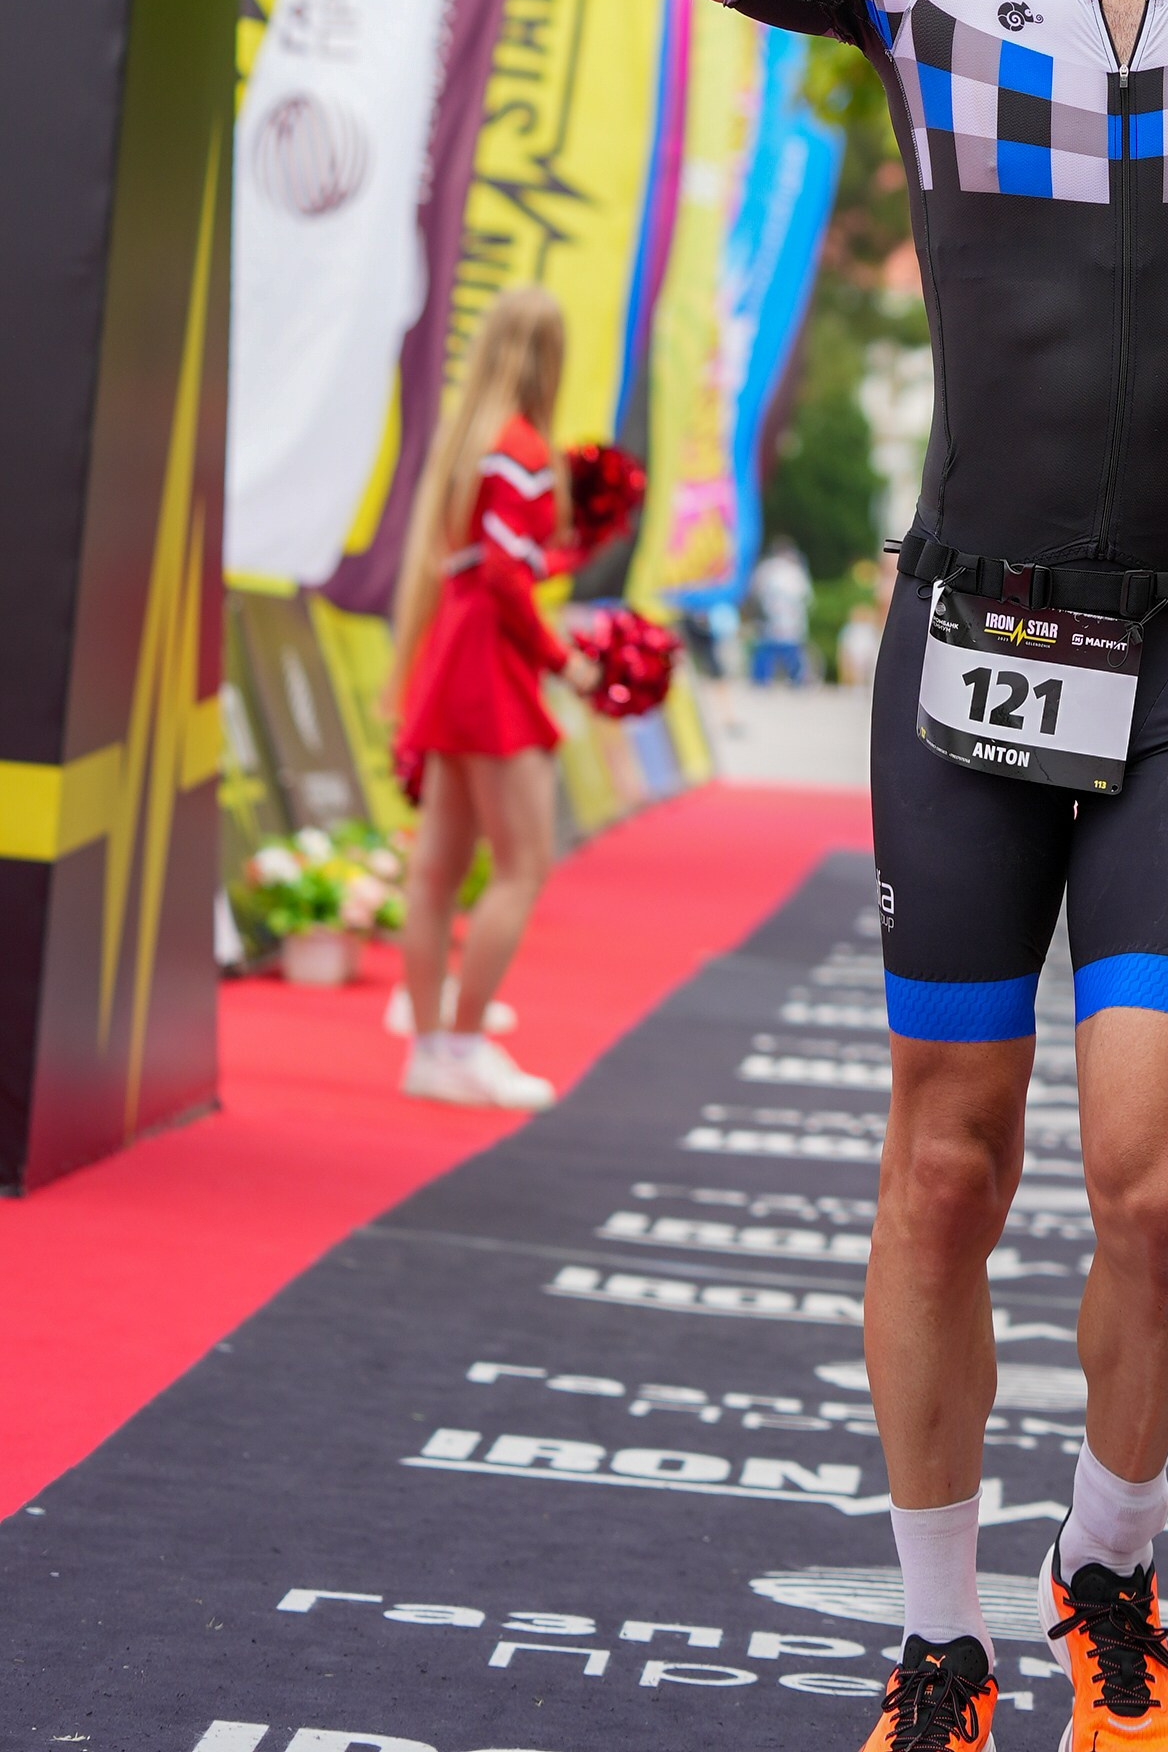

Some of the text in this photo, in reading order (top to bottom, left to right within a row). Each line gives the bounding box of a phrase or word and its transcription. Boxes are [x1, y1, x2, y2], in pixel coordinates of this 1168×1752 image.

[986, 612, 1059, 639] IRON STAR
[1085, 636, 1128, 652] МАГНИТ
[961, 666, 1063, 735] 121
[972, 742, 1031, 767] ANTON
[1093, 779, 1107, 789] 113
[420, 1428, 862, 1496] IRON
